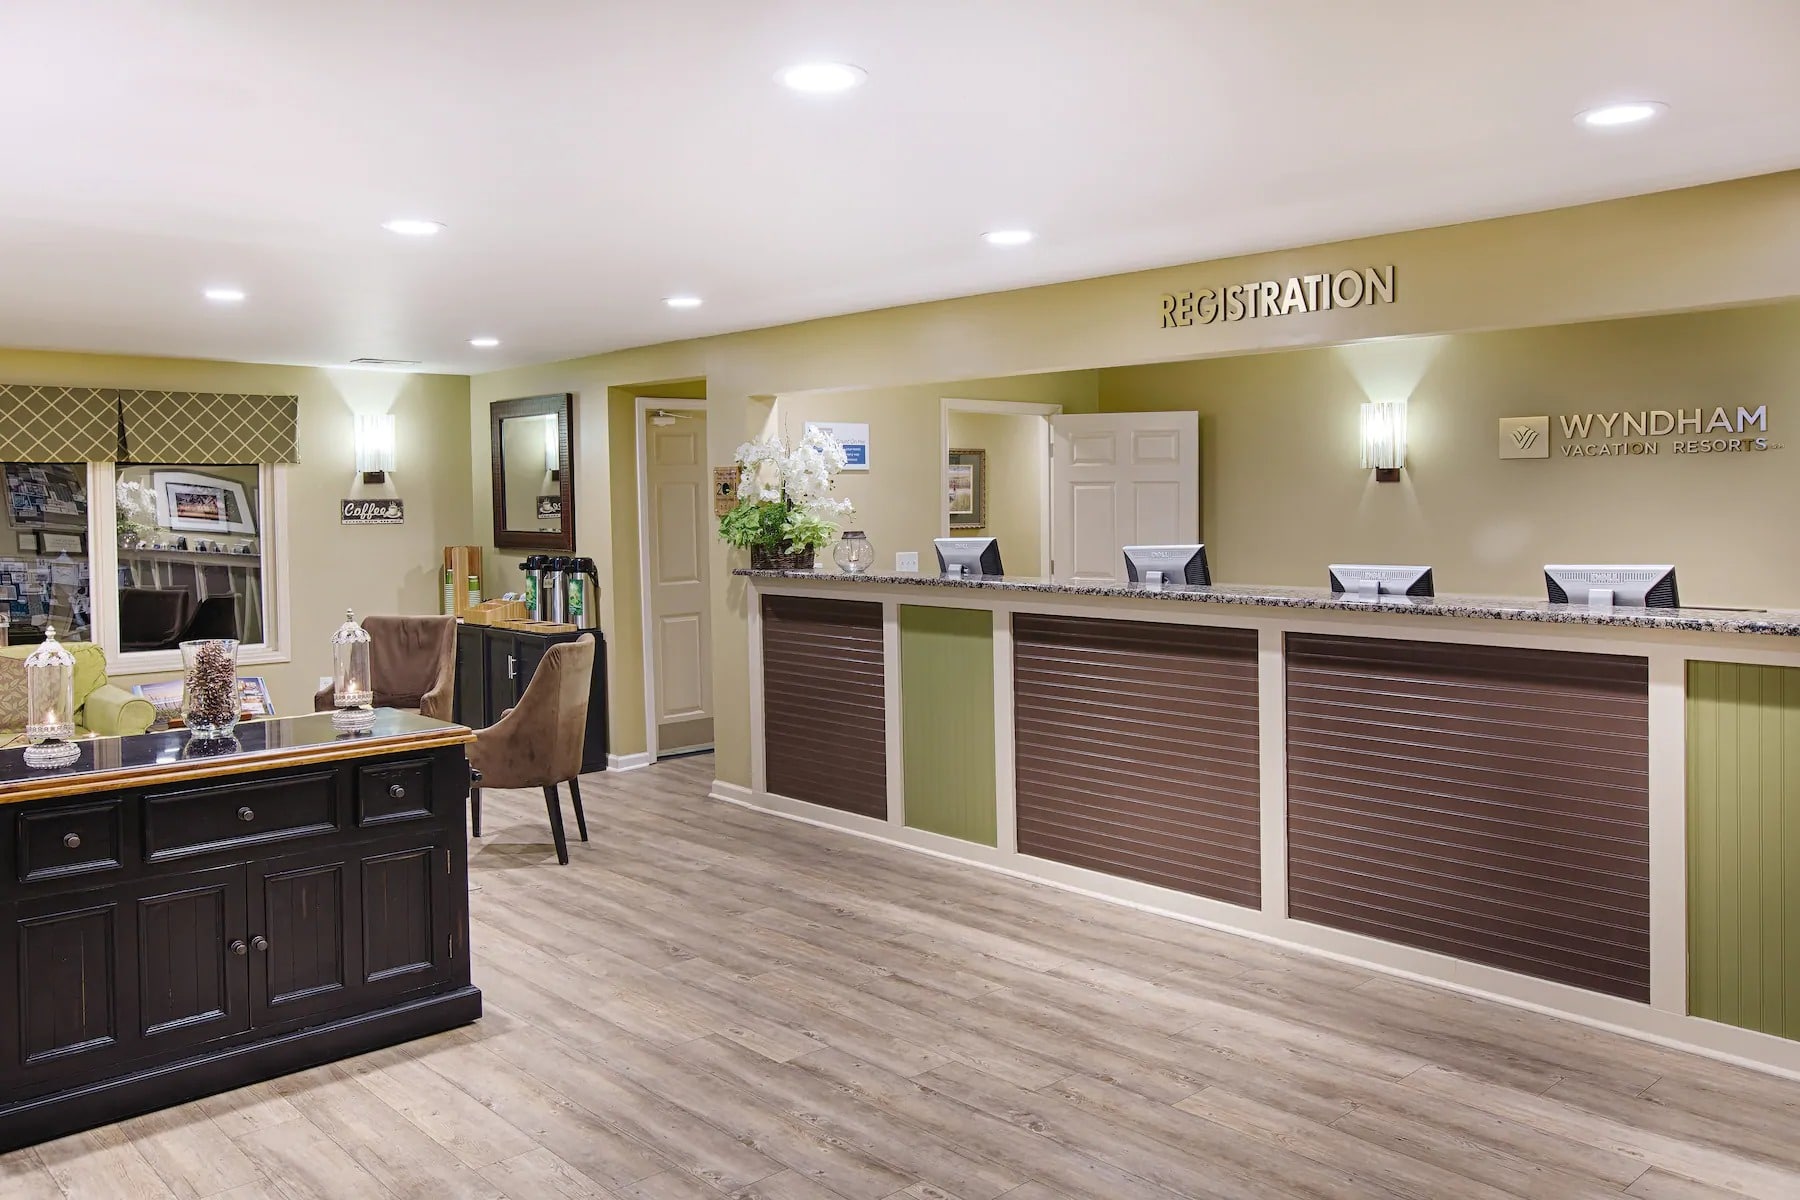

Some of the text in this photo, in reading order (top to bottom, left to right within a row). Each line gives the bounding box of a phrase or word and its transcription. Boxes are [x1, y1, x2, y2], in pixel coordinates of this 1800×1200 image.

[1160, 265, 1395, 328] REGISTRATION
[1559, 405, 1767, 439] WYNDHAM
[1561, 442, 1657, 457] VACATION
[1673, 437, 1767, 454] RESORTS
[345, 502, 386, 519] Coffee
